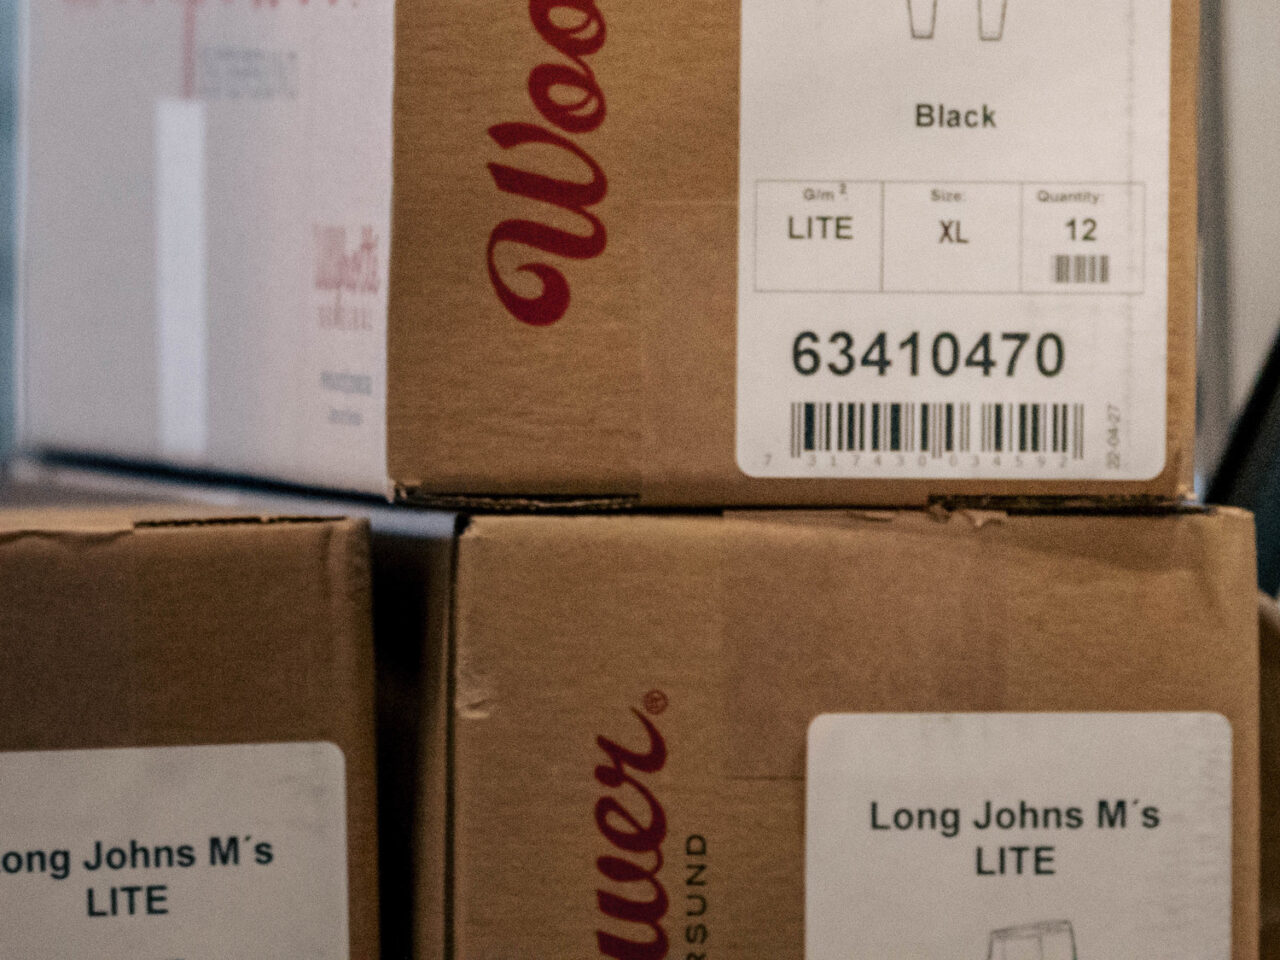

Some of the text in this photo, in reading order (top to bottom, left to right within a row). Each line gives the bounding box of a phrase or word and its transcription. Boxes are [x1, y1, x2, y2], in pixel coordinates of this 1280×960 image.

[915, 102, 997, 130] Black
[787, 215, 854, 241] LITE
[939, 220, 970, 244] XL
[1065, 217, 1098, 242] 12
[791, 330, 1066, 378] 63410470
[870, 800, 961, 838] Long
[972, 800, 1085, 831] Johns
[0, 848, 71, 881] ong
[82, 839, 197, 872] Johns
[975, 845, 1056, 876] LITE
[86, 884, 169, 918] LITE
